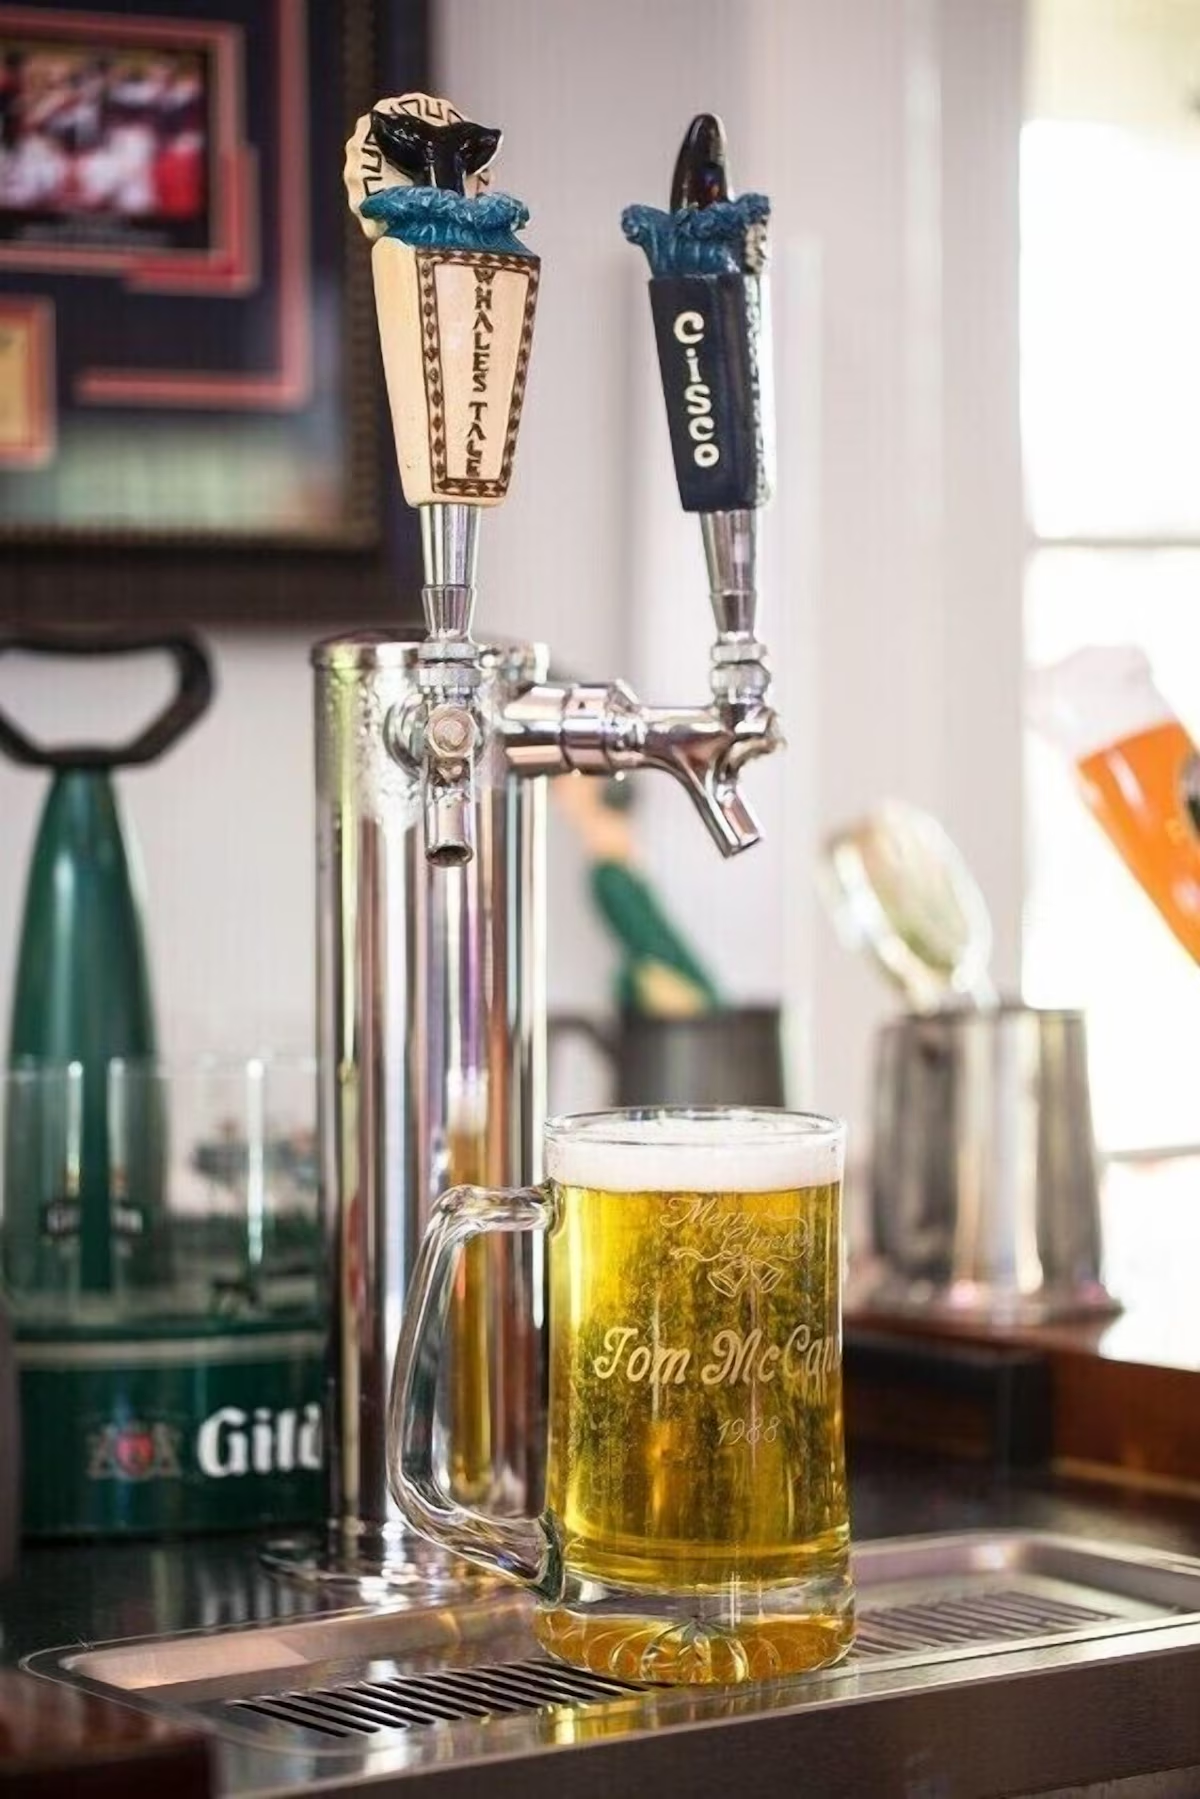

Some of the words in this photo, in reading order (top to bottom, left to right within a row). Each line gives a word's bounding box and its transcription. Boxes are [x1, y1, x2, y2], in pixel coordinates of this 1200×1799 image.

[471, 266, 496, 393] WHALES
[465, 401, 489, 477] TALE
[593, 1326, 691, 1384] Tom
[700, 1324, 842, 1386] McCan
[717, 1415, 781, 1446] 1988
